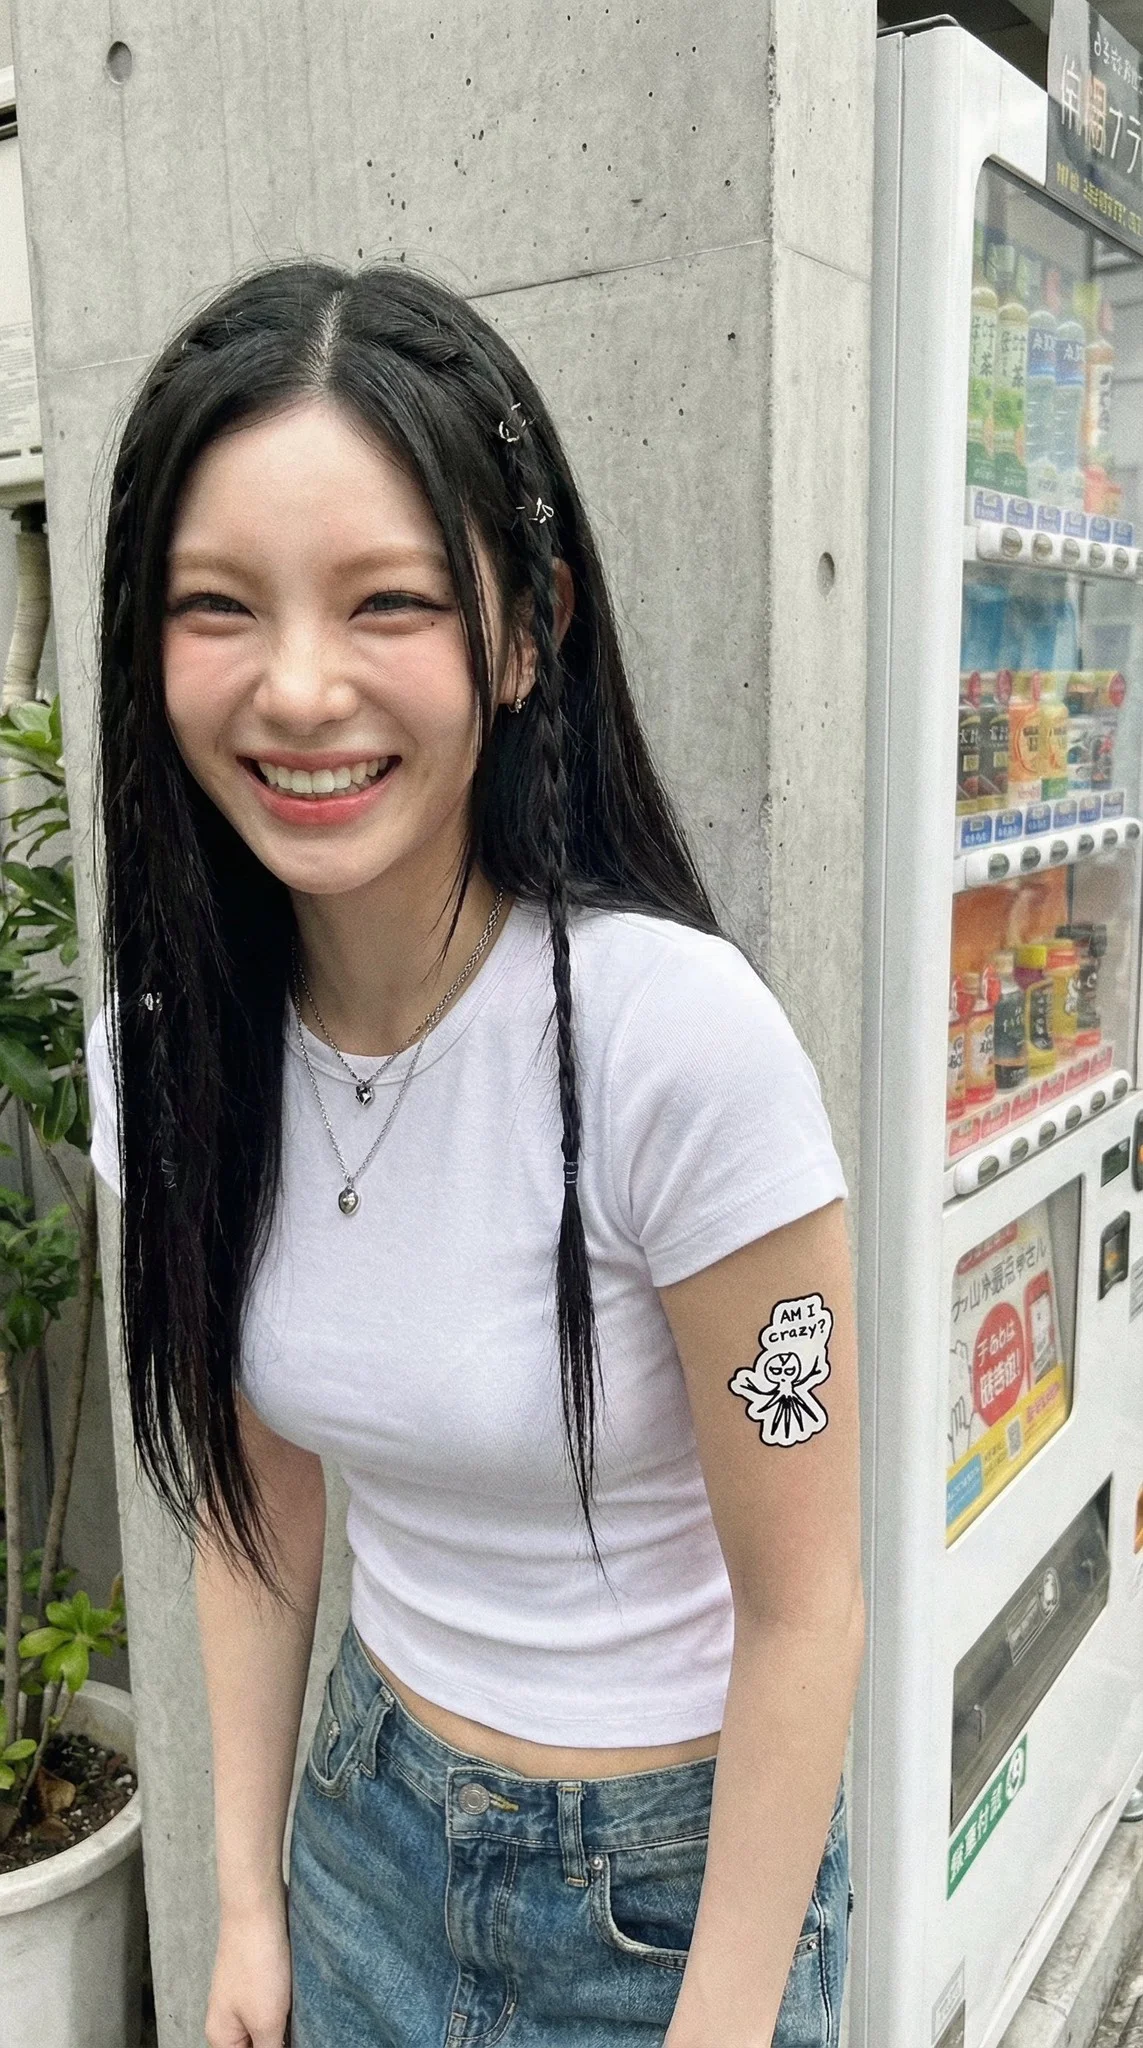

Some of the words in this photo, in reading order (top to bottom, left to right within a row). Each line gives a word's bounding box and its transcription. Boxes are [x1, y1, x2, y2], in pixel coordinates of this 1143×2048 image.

[780, 1307, 802, 1324] AM
[807, 1303, 816, 1318] I
[768, 1318, 826, 1343] crazy?
